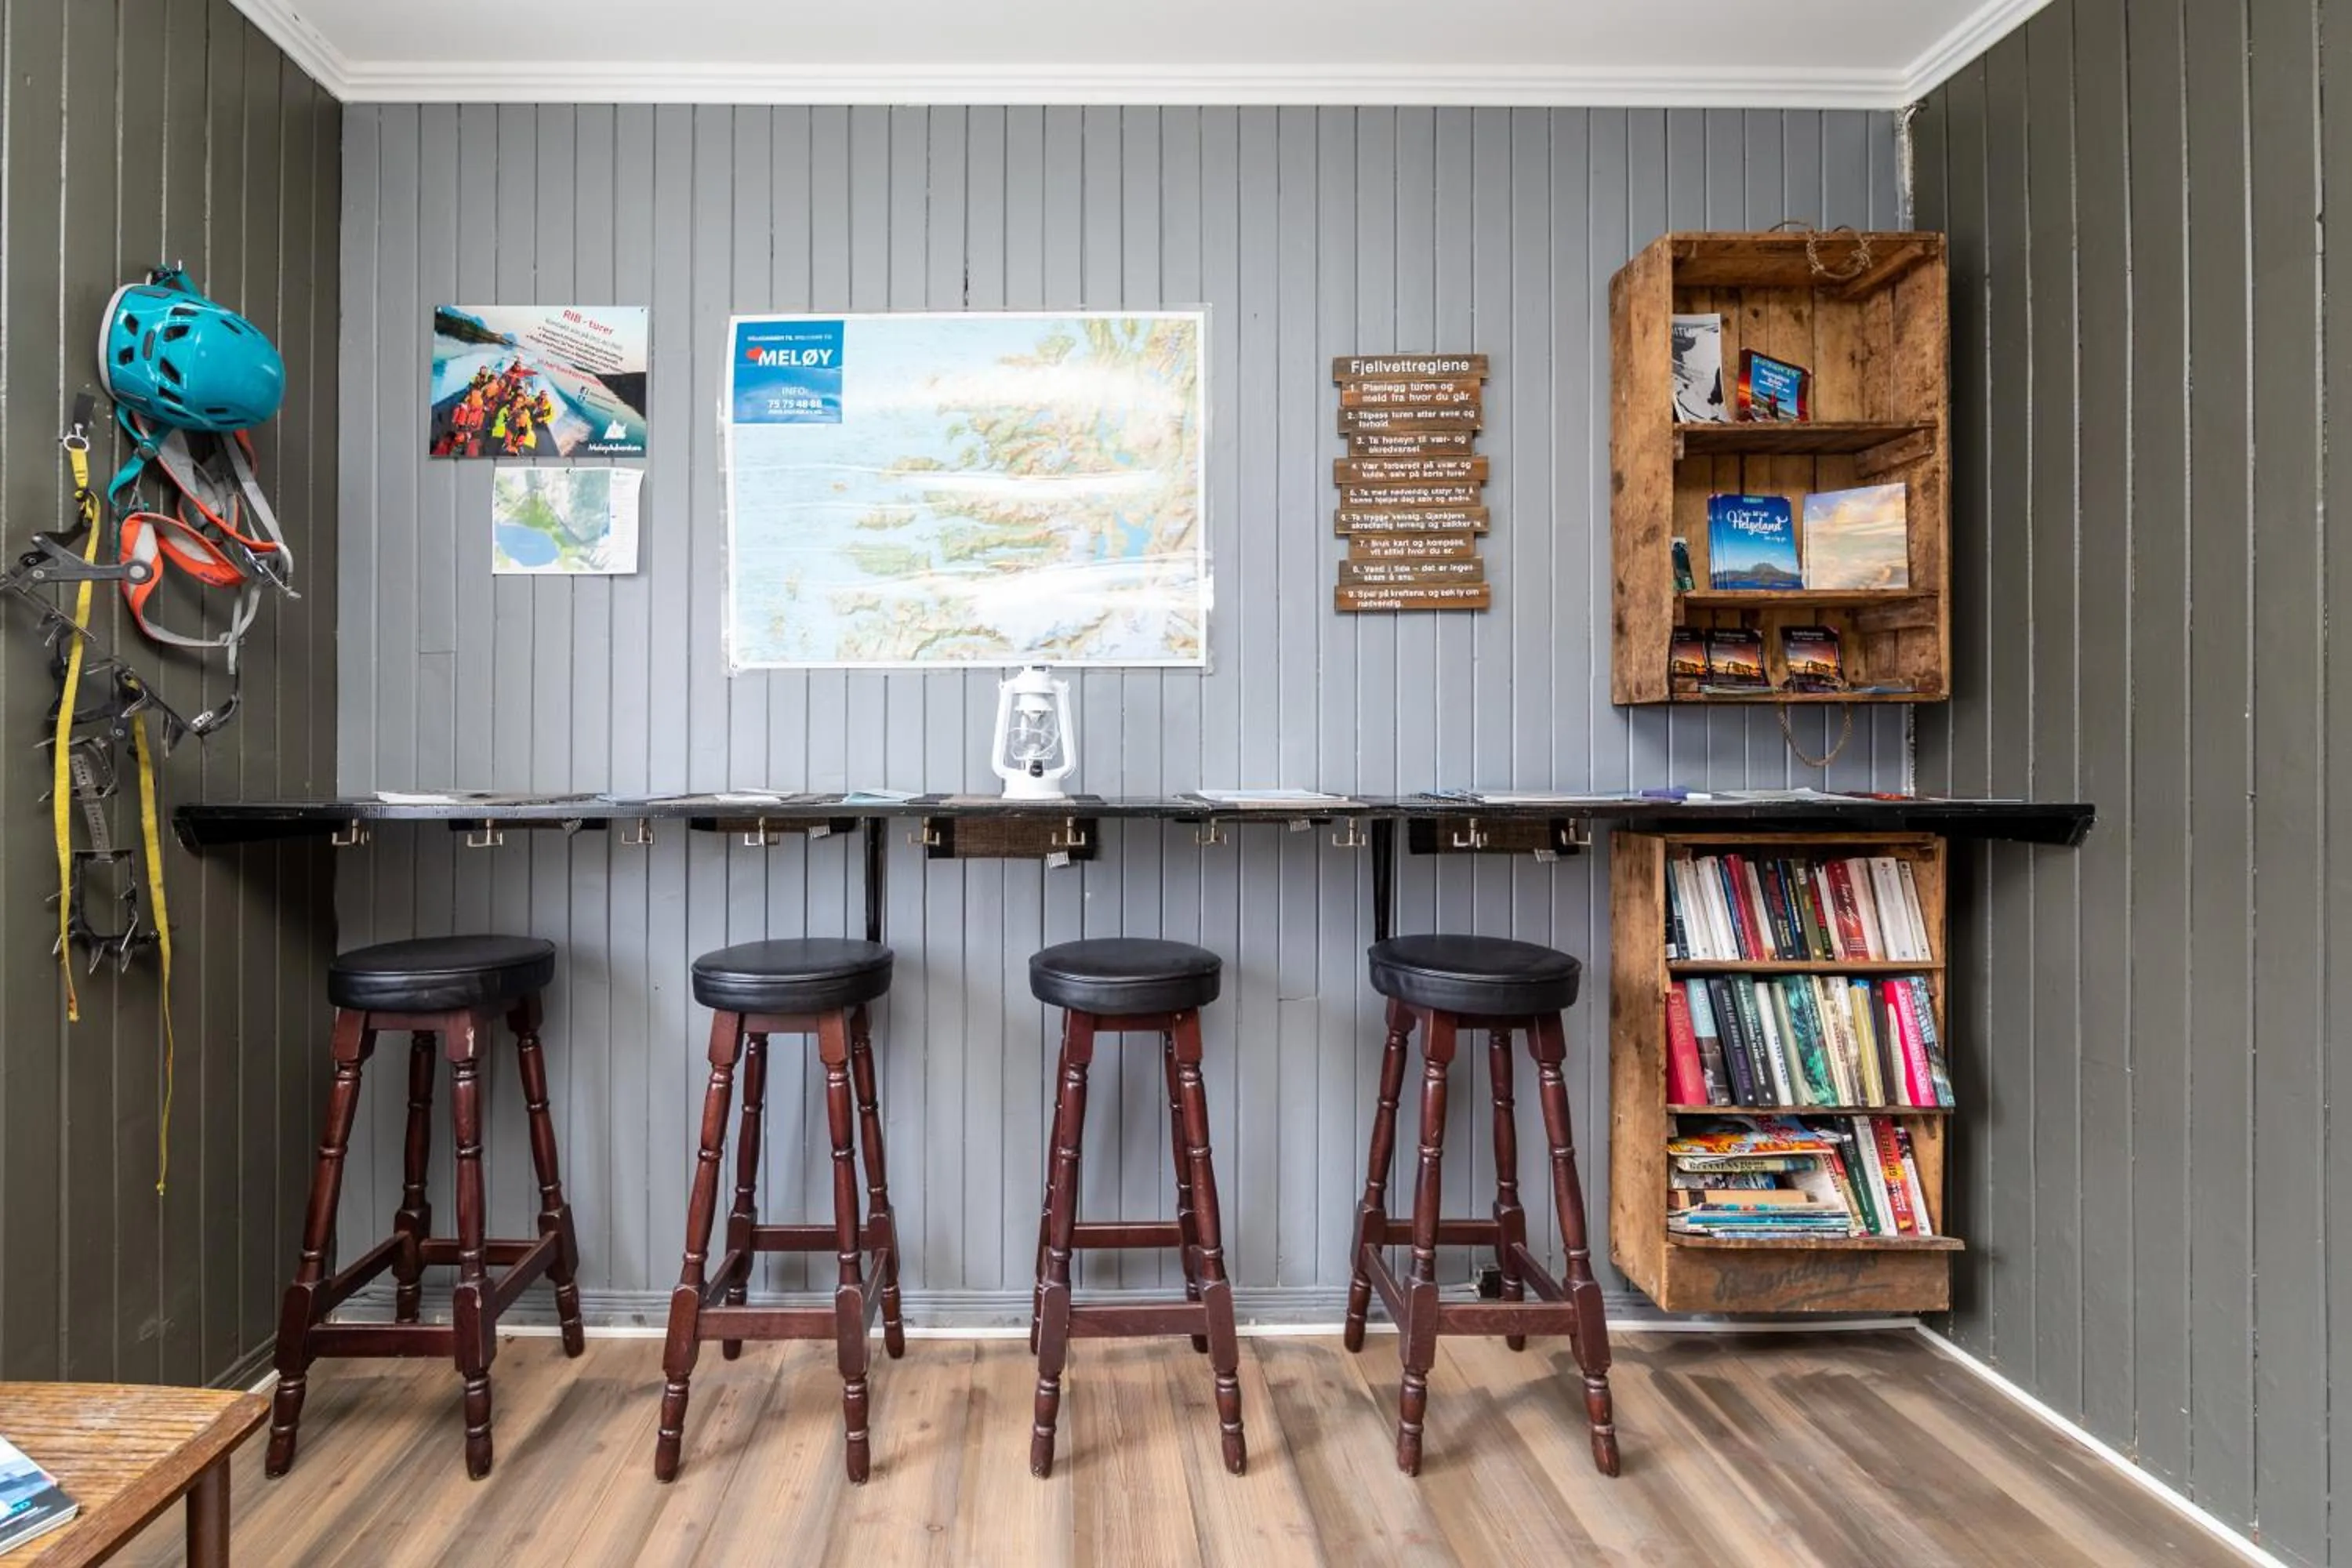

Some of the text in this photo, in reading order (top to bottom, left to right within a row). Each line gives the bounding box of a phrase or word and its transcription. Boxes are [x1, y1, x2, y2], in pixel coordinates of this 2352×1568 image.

[562, 309, 583, 324] RIB
[757, 348, 833, 366] MELØY
[1351, 359, 1470, 376] Fjellvettreglene
[1362, 383, 1406, 393] Planlegg
[1410, 383, 1436, 392] turen
[1441, 383, 1454, 393] og
[1362, 392, 1387, 402] meld
[1392, 392, 1406, 402] fra
[1409, 392, 1432, 402] hvor
[1436, 392, 1449, 401] du
[1463, 409, 1475, 419] og
[1368, 436, 1379, 445] Ta
[1454, 435, 1466, 445] og
[1423, 460, 1435, 471] på
[1461, 461, 1472, 470] og
[1409, 470, 1420, 479] på
[1428, 521, 1439, 529] og
[1412, 539, 1423, 548] og
[1407, 547, 1425, 556] hvor
[1378, 589, 1388, 598] på
